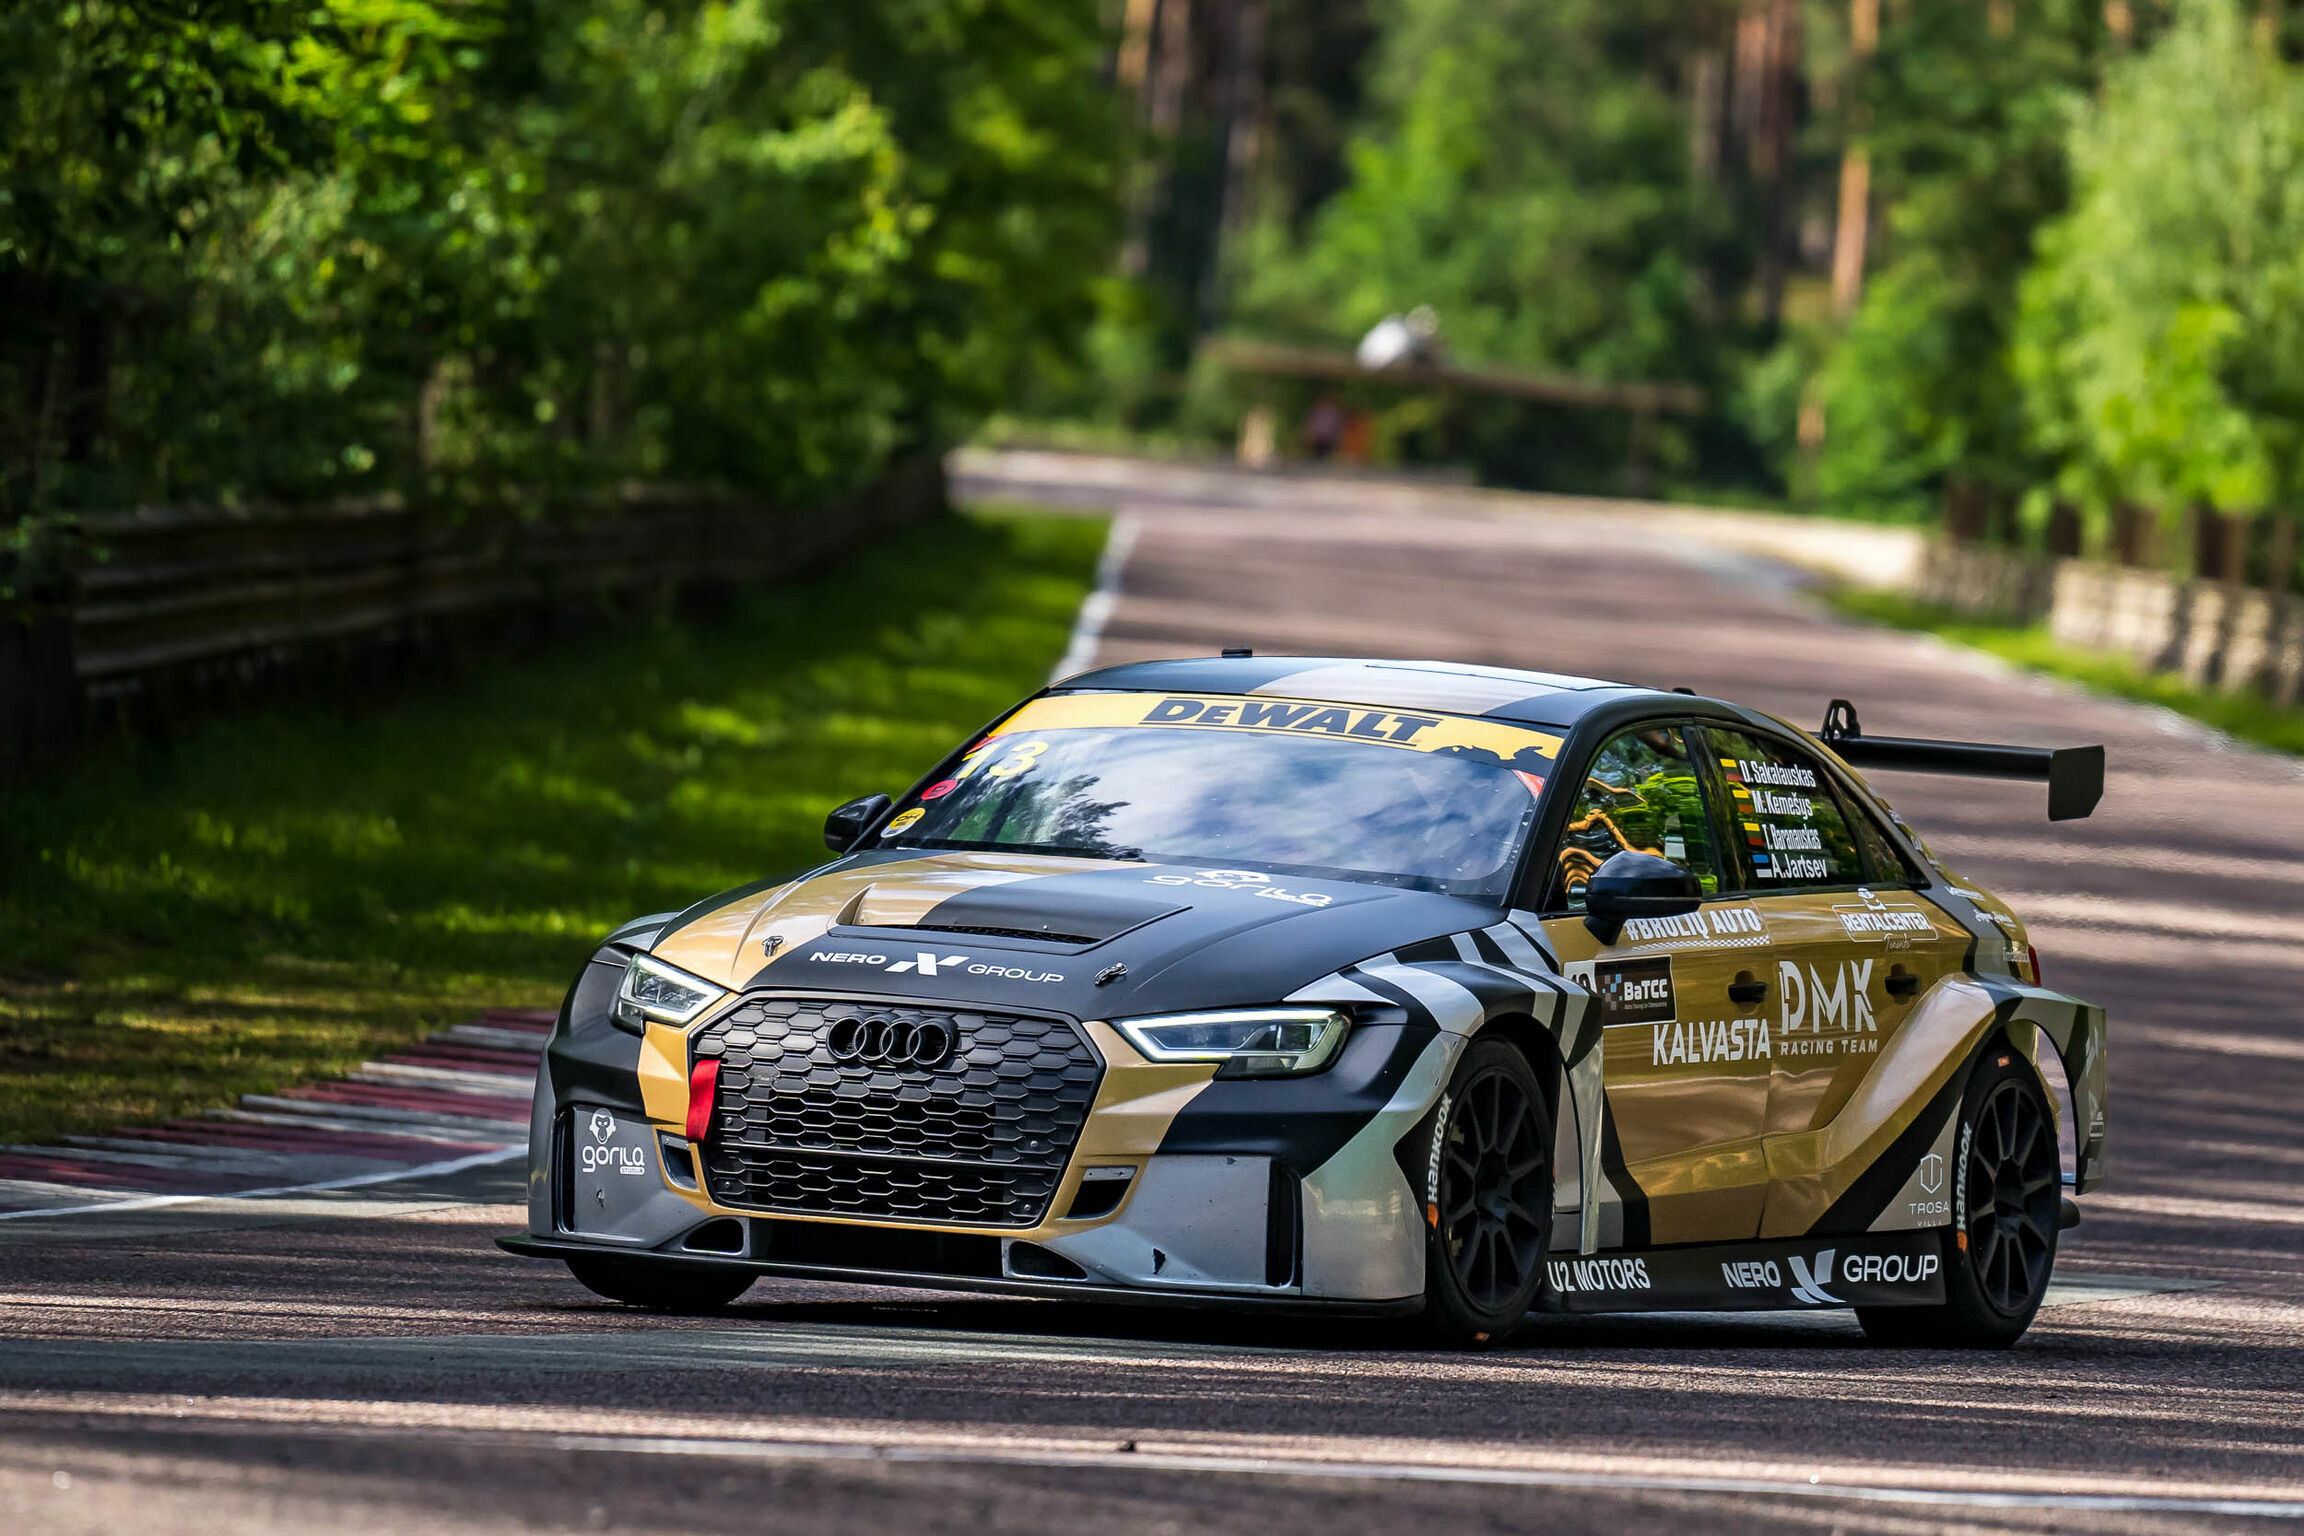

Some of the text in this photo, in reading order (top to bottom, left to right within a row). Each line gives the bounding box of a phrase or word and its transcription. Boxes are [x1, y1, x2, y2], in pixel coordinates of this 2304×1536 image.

[956, 741, 1049, 779] 13
[1709, 908, 1763, 934] AUTO
[809, 952, 1065, 983] NERO GROUP
[1624, 979, 1668, 1001] BaTCC
[1779, 958, 1878, 1035] DMK
[1652, 1018, 1772, 1066] KALVASTA
[1780, 1038, 1878, 1055] RACING TEAM
[582, 1145, 645, 1173] gorila
[1908, 1201, 1950, 1215] TROSA
[1546, 1257, 1652, 1292] U2 MOTORS
[1721, 1254, 1939, 1288] NERO GROUP
